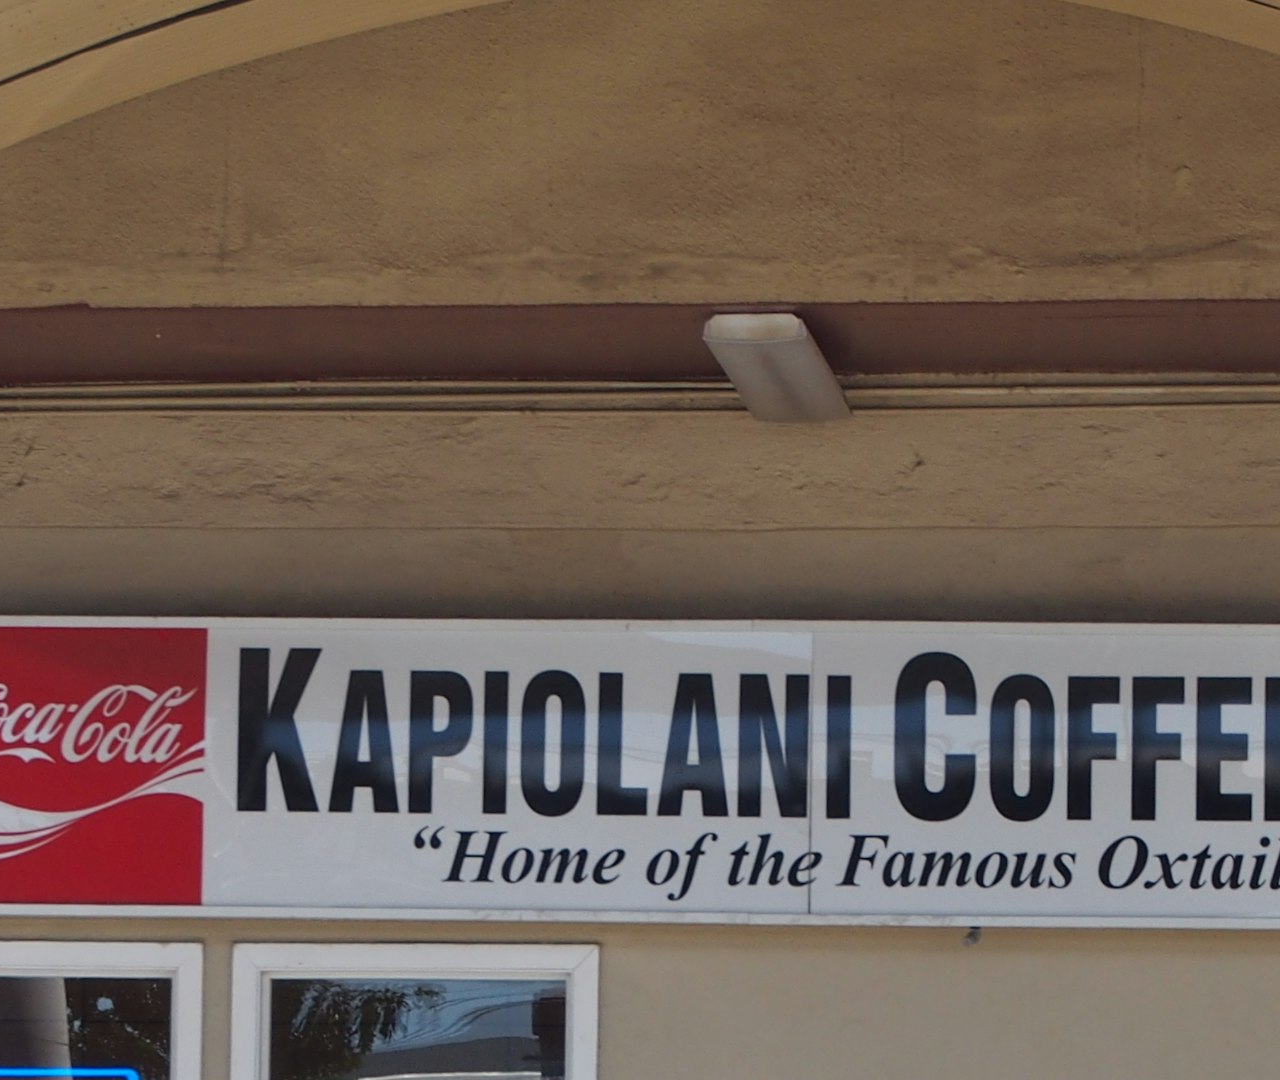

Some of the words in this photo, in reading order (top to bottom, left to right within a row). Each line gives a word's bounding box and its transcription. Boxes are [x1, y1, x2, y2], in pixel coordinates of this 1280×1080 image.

[236, 647, 851, 819] KAPIOLANI
[646, 832, 719, 901] of
[730, 832, 817, 887] the
[840, 833, 1077, 890] Famous
